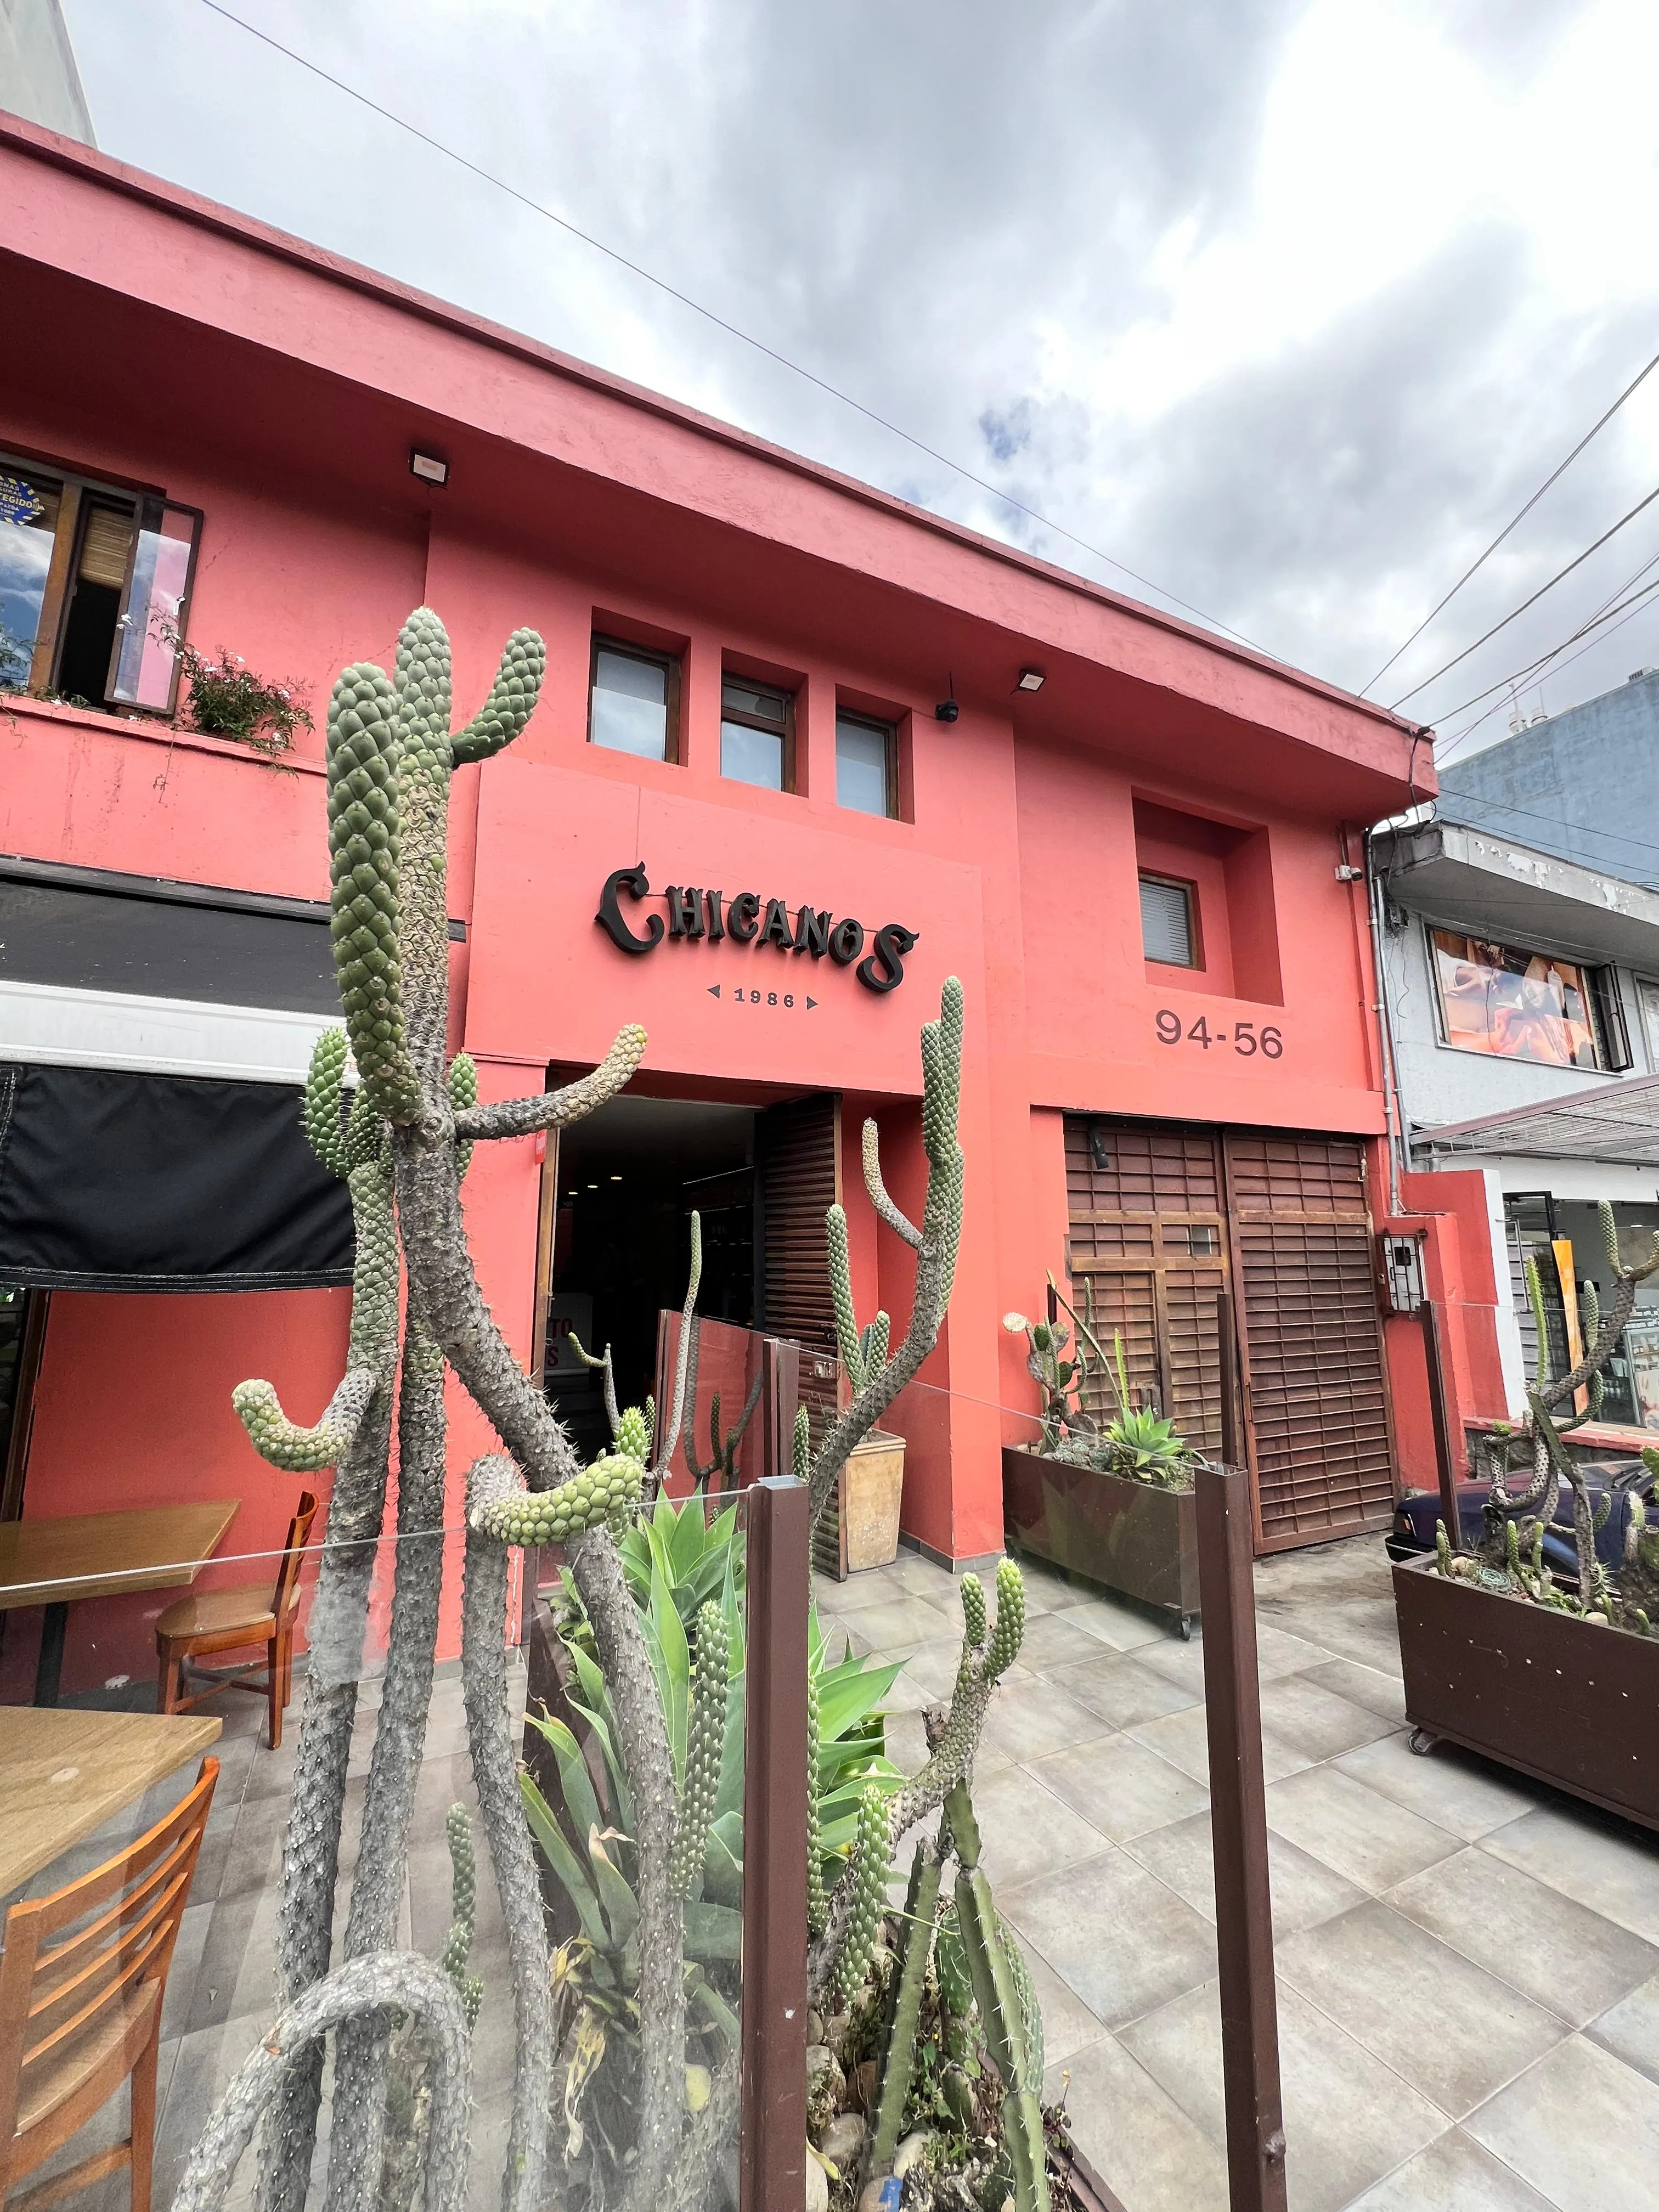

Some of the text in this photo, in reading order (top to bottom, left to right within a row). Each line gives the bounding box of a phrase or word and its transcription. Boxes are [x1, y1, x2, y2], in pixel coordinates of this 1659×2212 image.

[595, 861, 921, 994] CHICANOS
[734, 988, 795, 1008] 1986
[1155, 1009, 1283, 1059] 94-56
